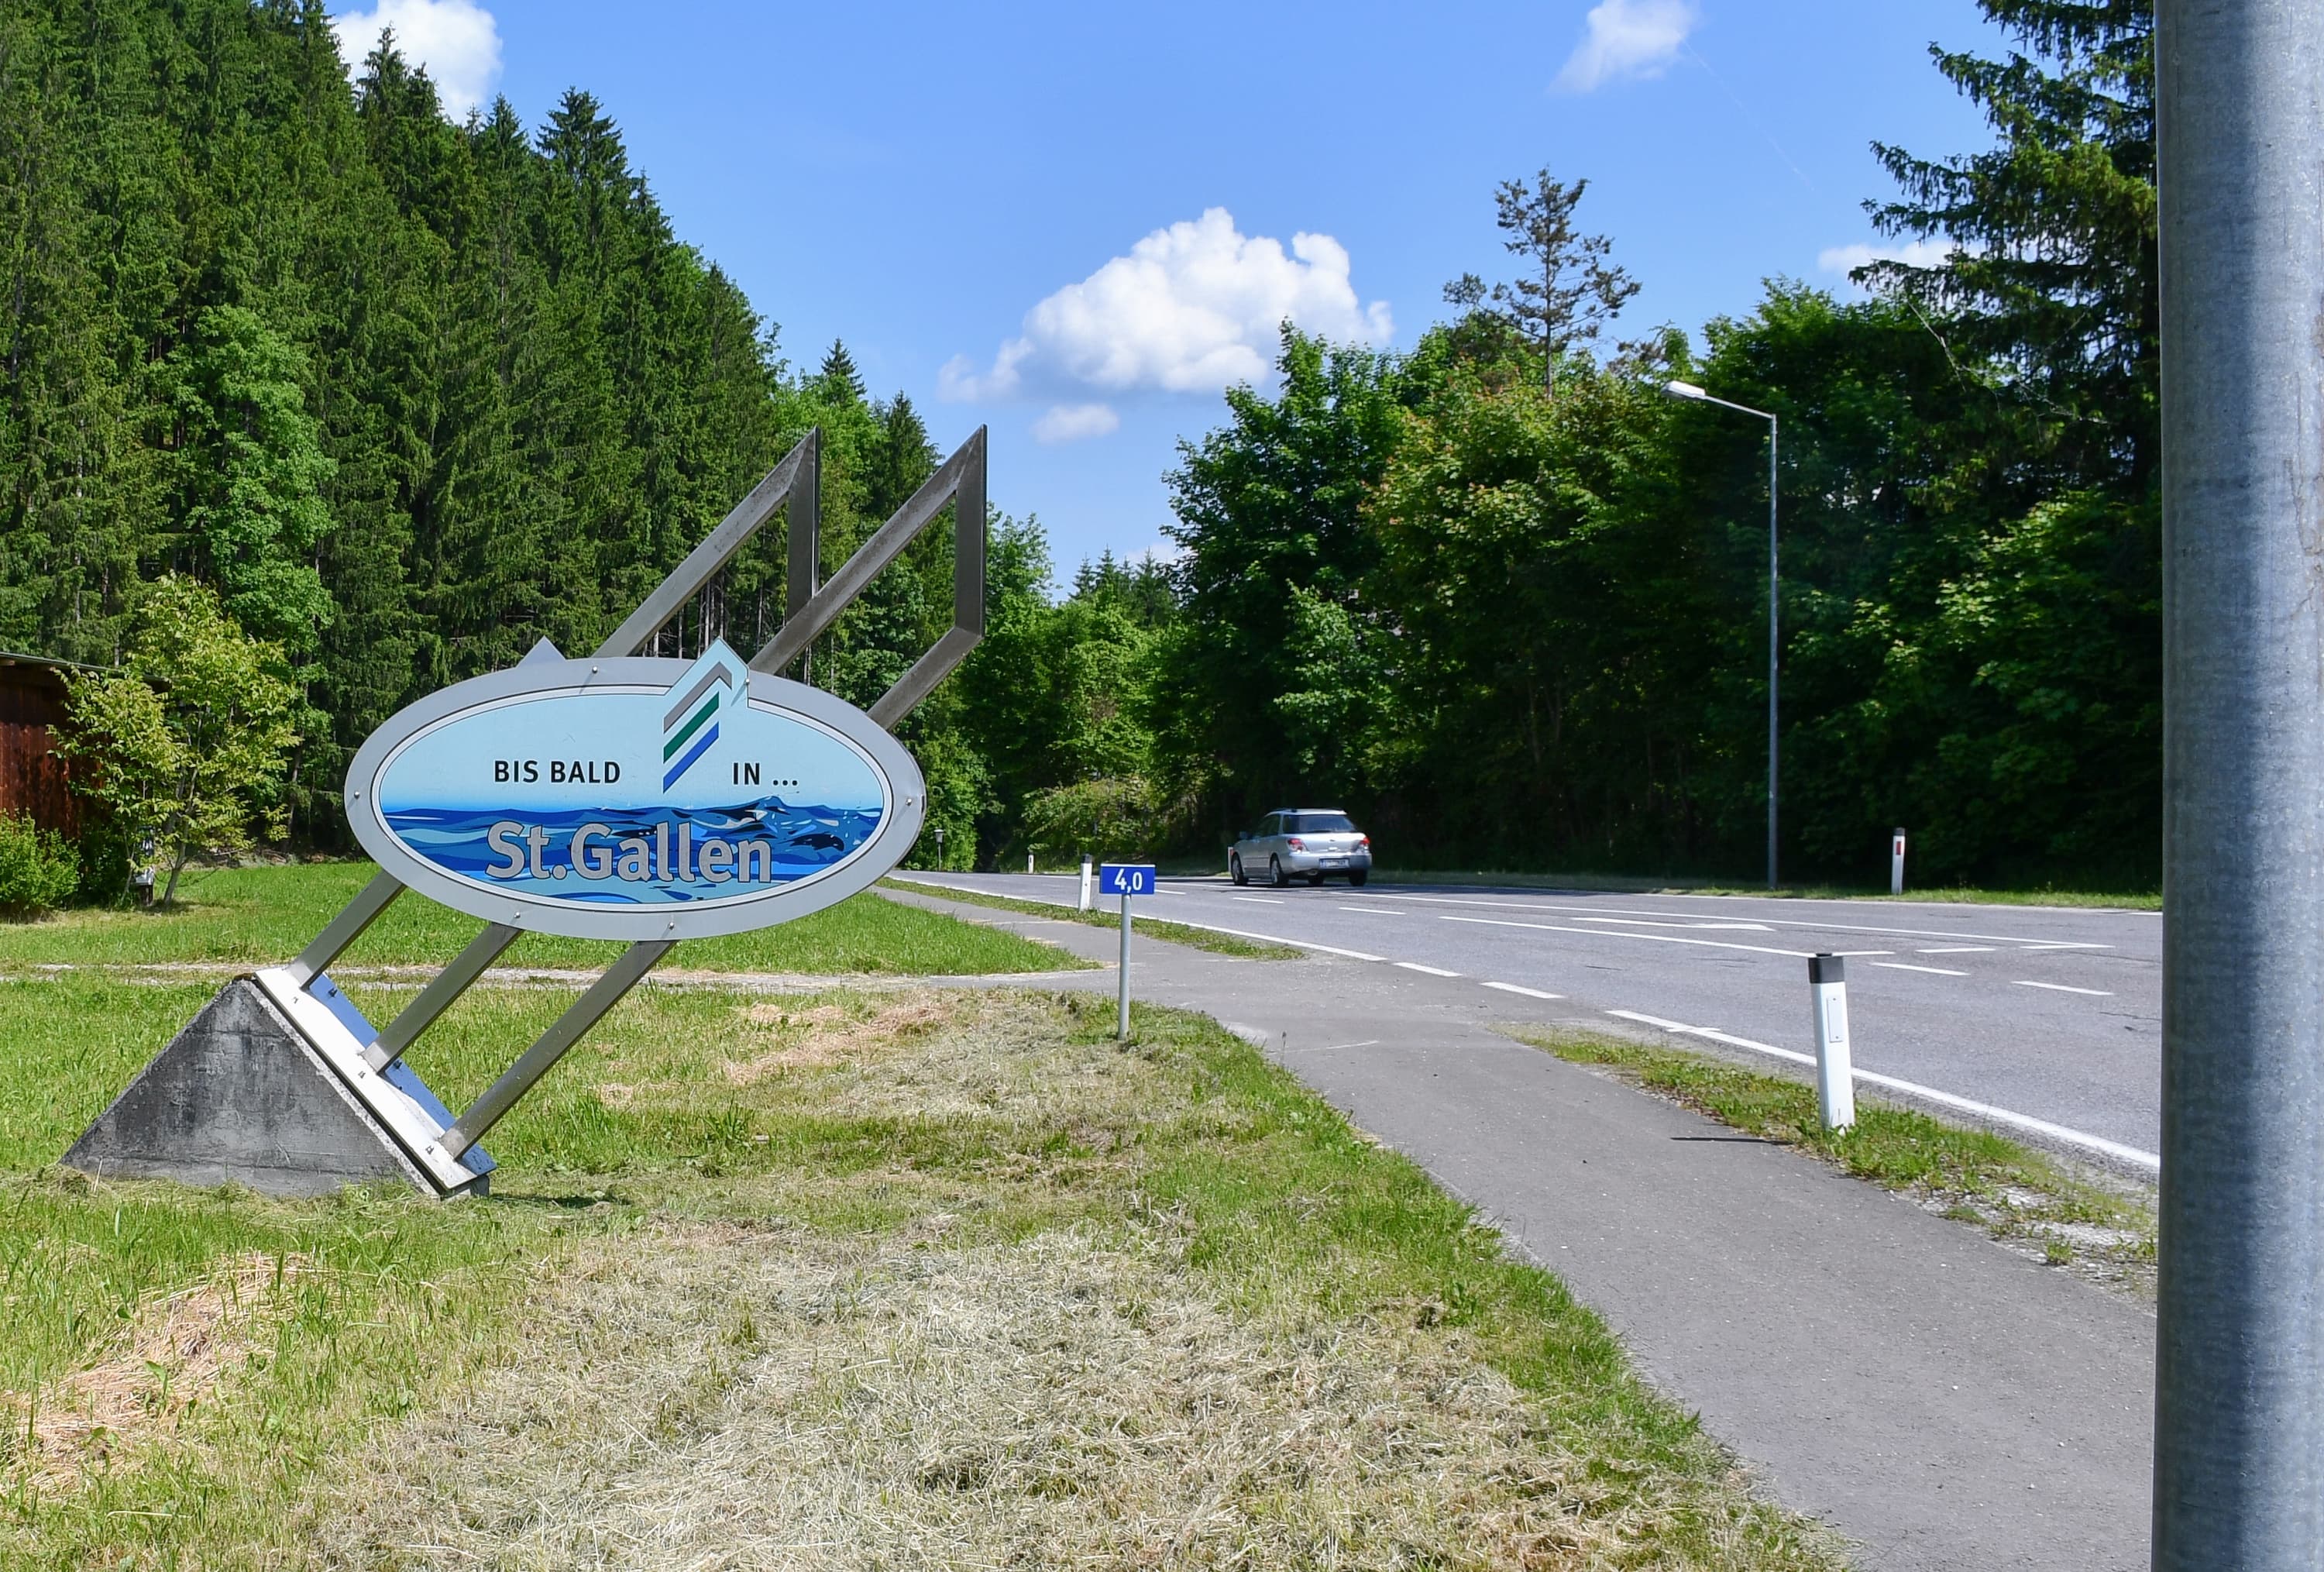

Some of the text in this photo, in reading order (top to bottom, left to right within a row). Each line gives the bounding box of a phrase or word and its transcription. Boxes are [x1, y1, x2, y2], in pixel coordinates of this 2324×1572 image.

[493, 760, 538, 783] BIS
[551, 761, 621, 784] BALD
[733, 762, 761, 786] IN
[1114, 868, 1143, 893] 4,0
